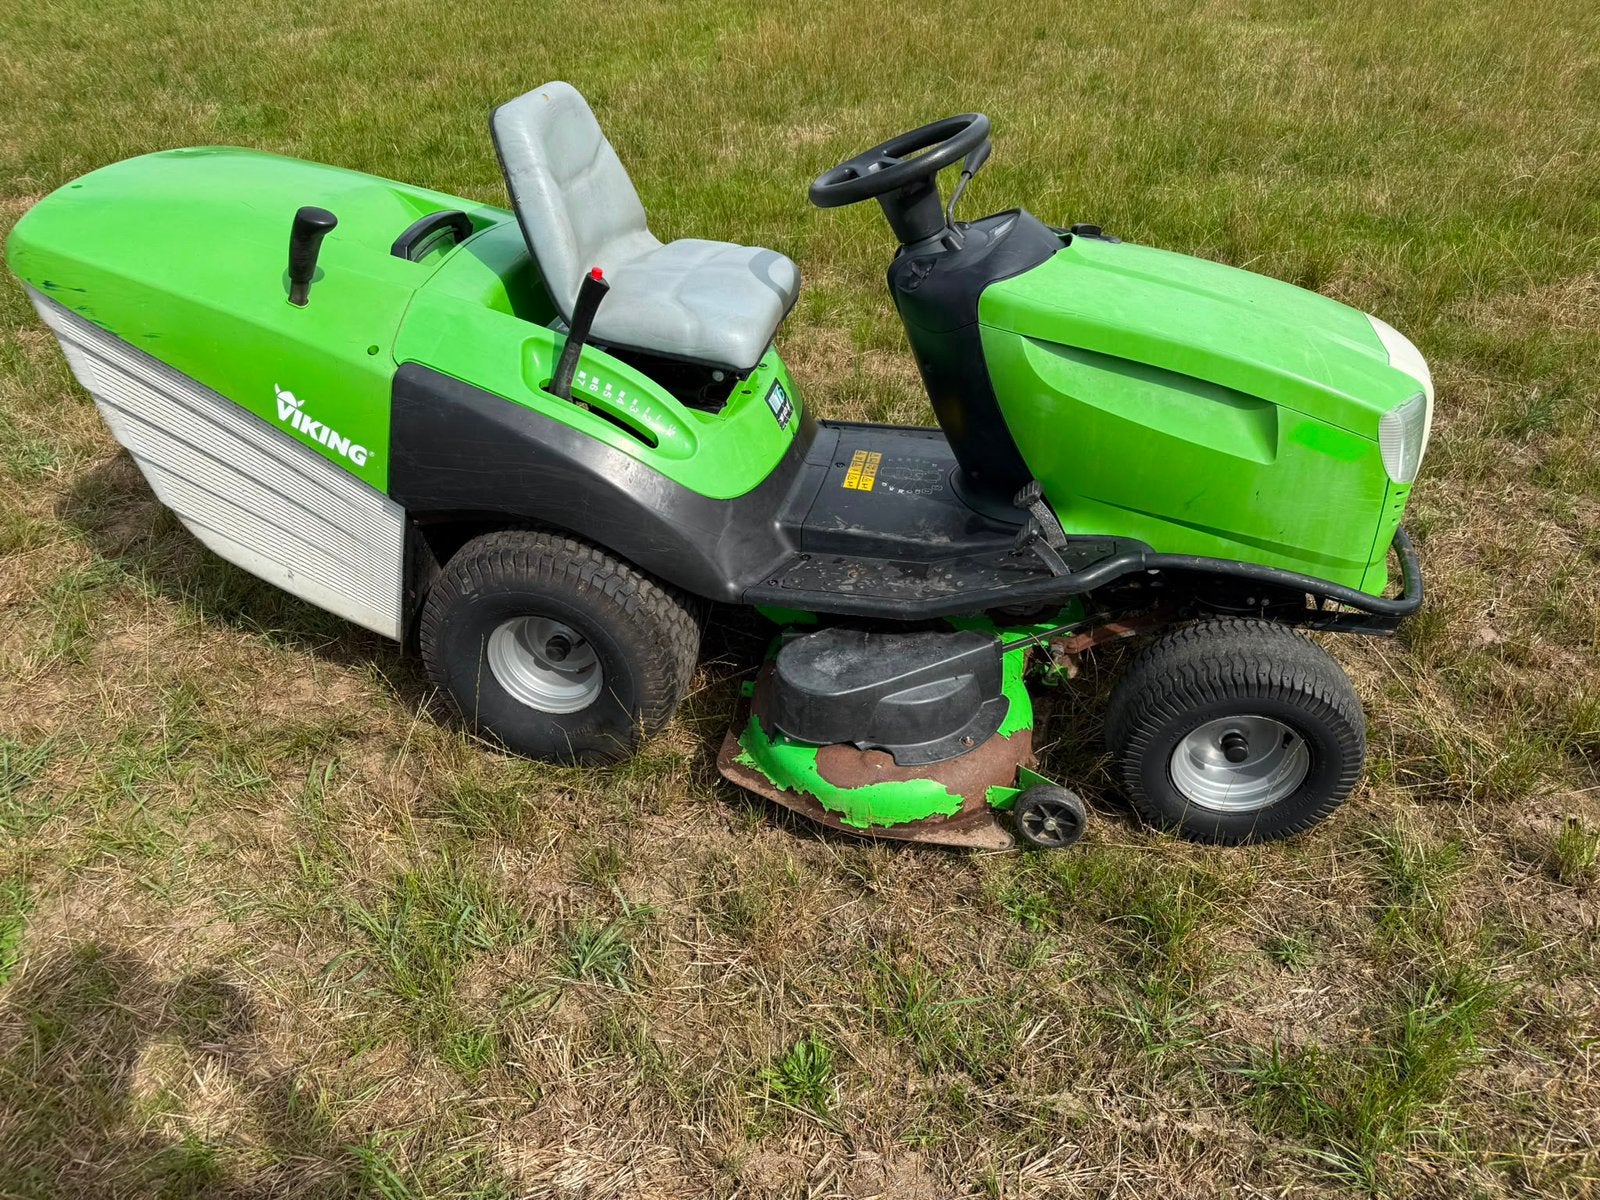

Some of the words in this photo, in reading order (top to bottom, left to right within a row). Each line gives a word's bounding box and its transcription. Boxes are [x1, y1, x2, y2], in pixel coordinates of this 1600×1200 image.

[577, 378, 586, 386] 7
[589, 383, 599, 392] 6
[603, 390, 612, 399] 5
[616, 397, 625, 406] 4
[276, 397, 368, 467] VIKING
